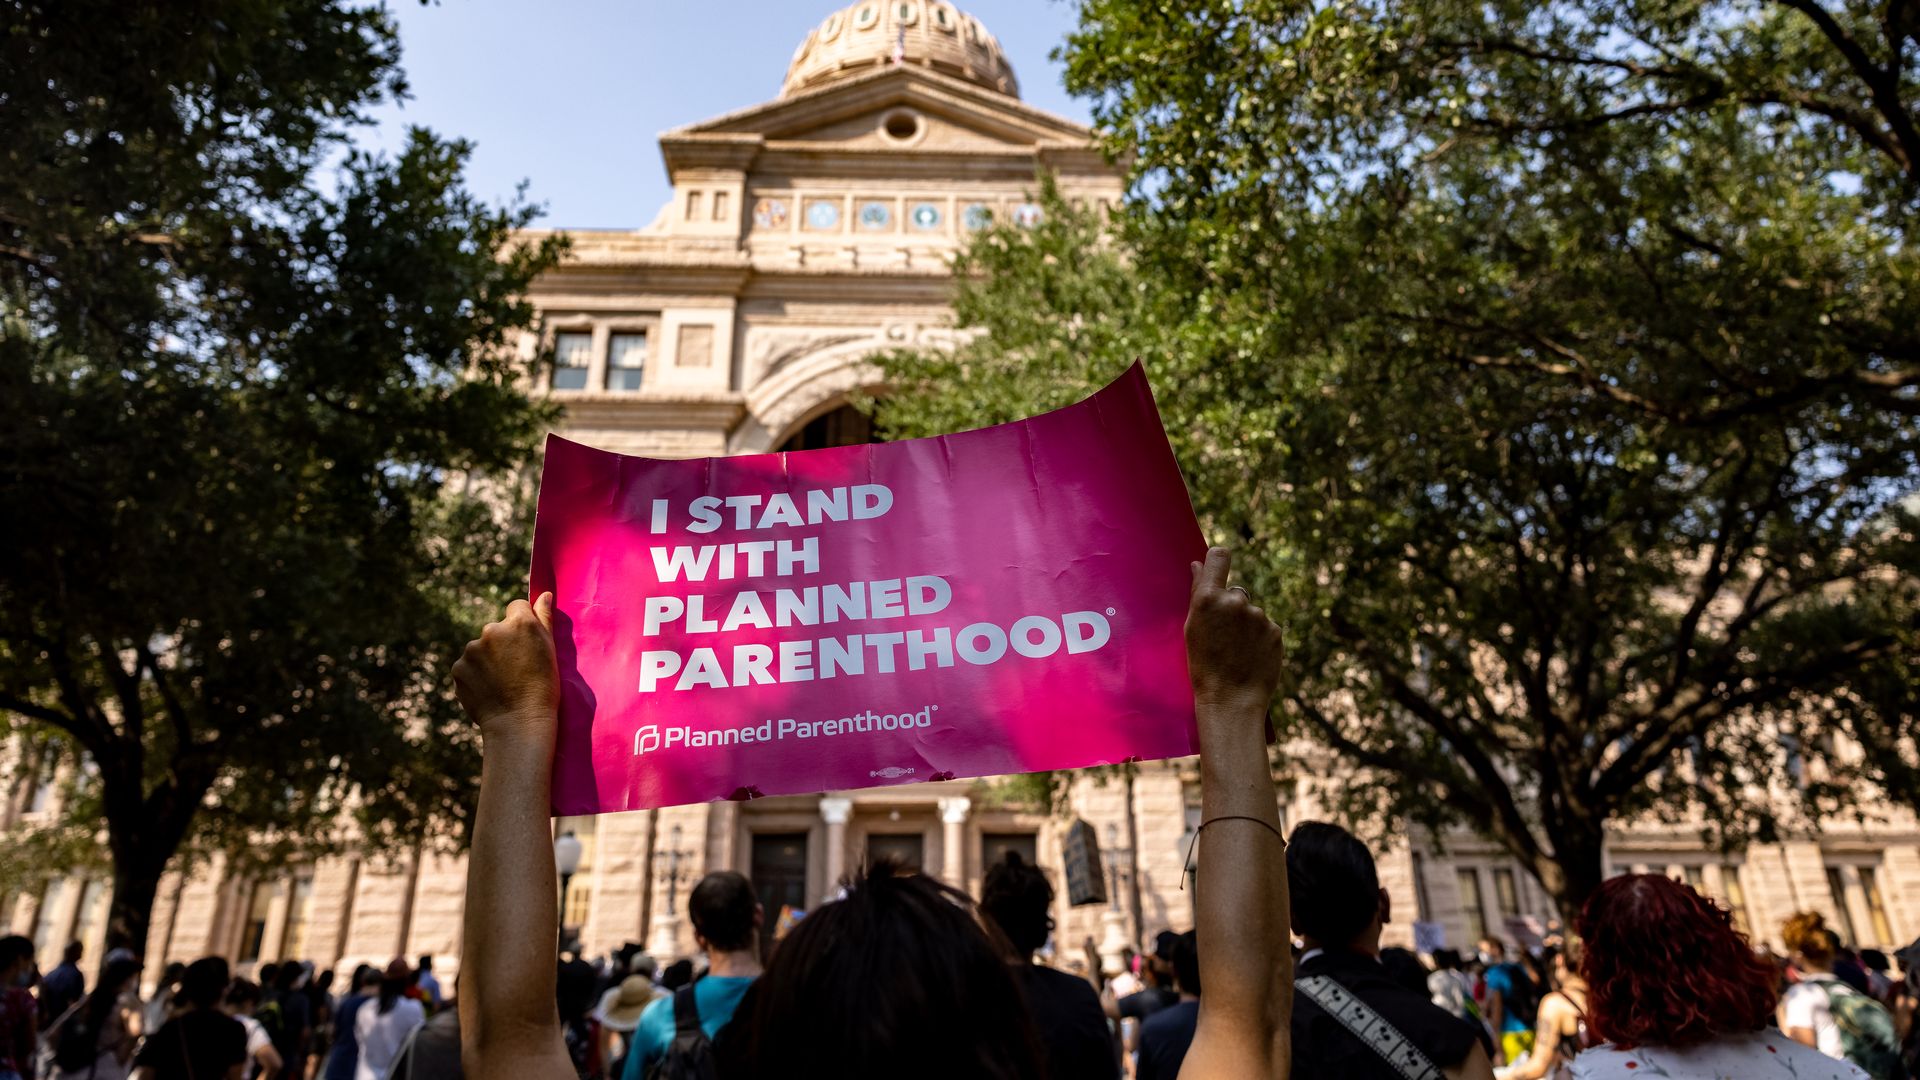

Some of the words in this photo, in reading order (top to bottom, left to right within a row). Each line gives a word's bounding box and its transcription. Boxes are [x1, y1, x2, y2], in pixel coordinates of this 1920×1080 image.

[650, 499, 669, 534] I
[687, 483, 894, 534] STAND
[649, 537, 819, 583] WITH
[642, 574, 952, 636] PLANNED
[664, 719, 772, 748] Planned
